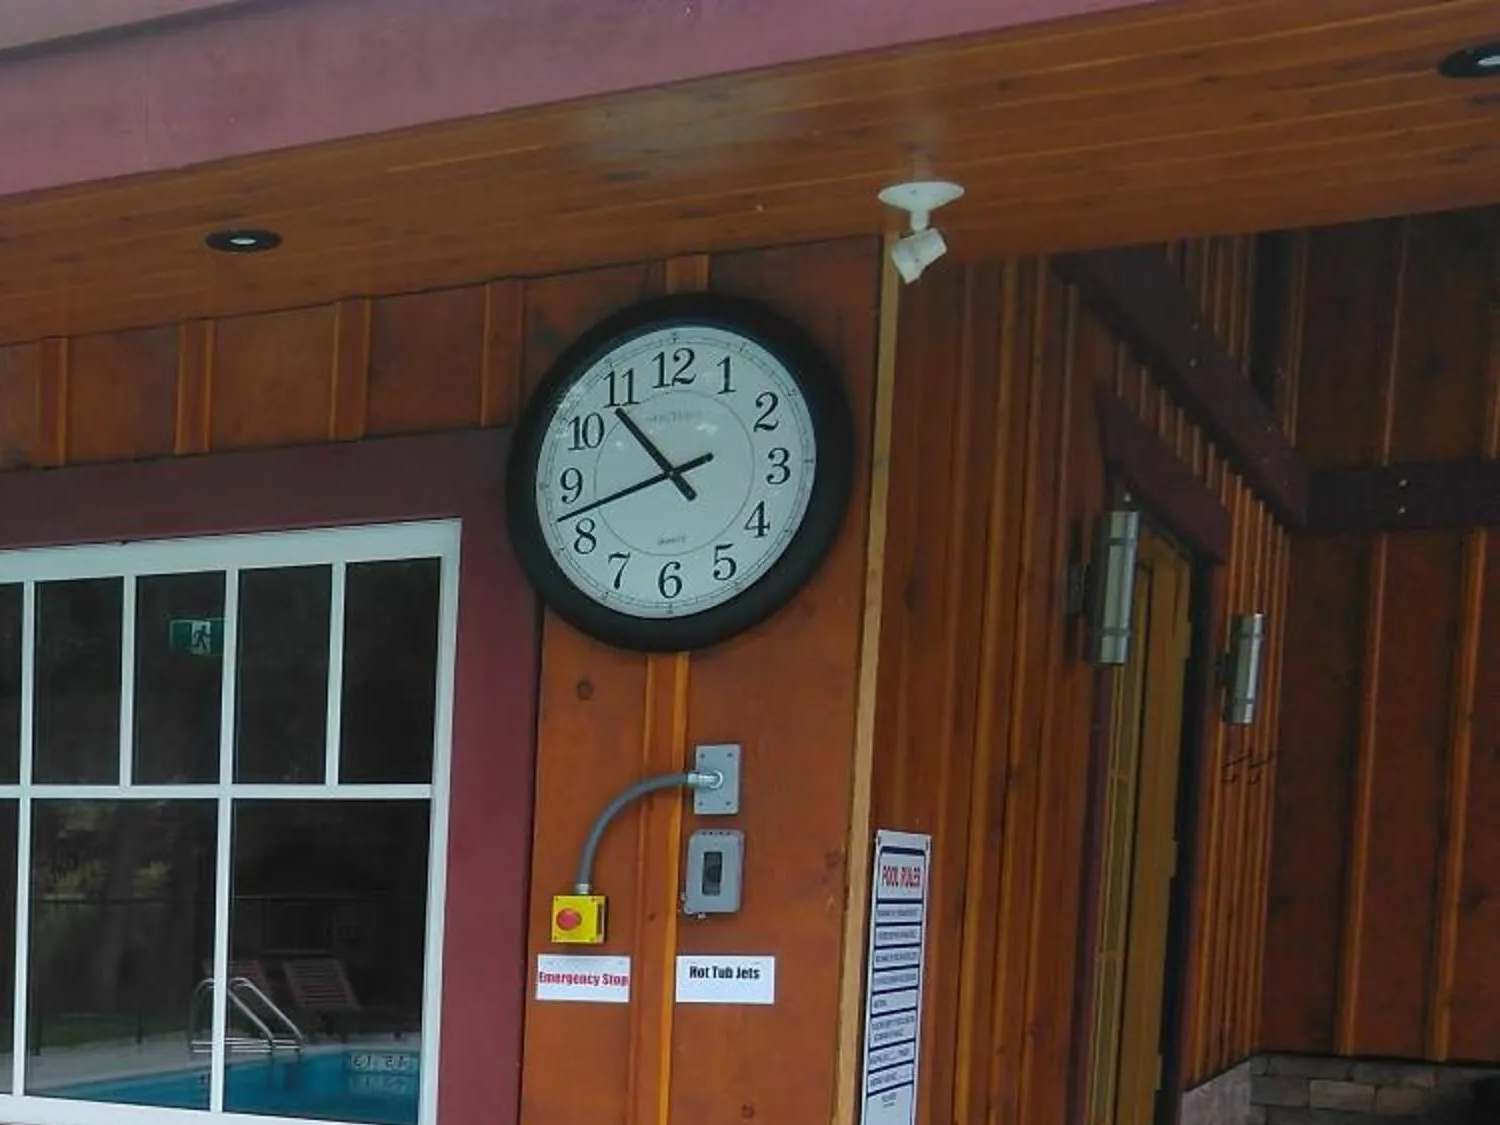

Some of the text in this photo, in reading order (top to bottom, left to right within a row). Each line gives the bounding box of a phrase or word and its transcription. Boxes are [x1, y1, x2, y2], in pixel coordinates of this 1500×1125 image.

[651, 348, 697, 389] 12
[716, 356, 736, 394] 1
[603, 368, 641, 409] 11
[753, 392, 779, 432] 2
[567, 412, 604, 451] 10
[766, 447, 790, 484] 3
[560, 467, 583, 504] 9
[573, 517, 597, 554] 8
[743, 500, 770, 538] 4
[607, 551, 630, 589] 7
[658, 561, 682, 598] 6
[713, 543, 737, 580] 5
[539, 971, 629, 987] Emergency Stop
[689, 965, 761, 980] Hot Tub Jets
